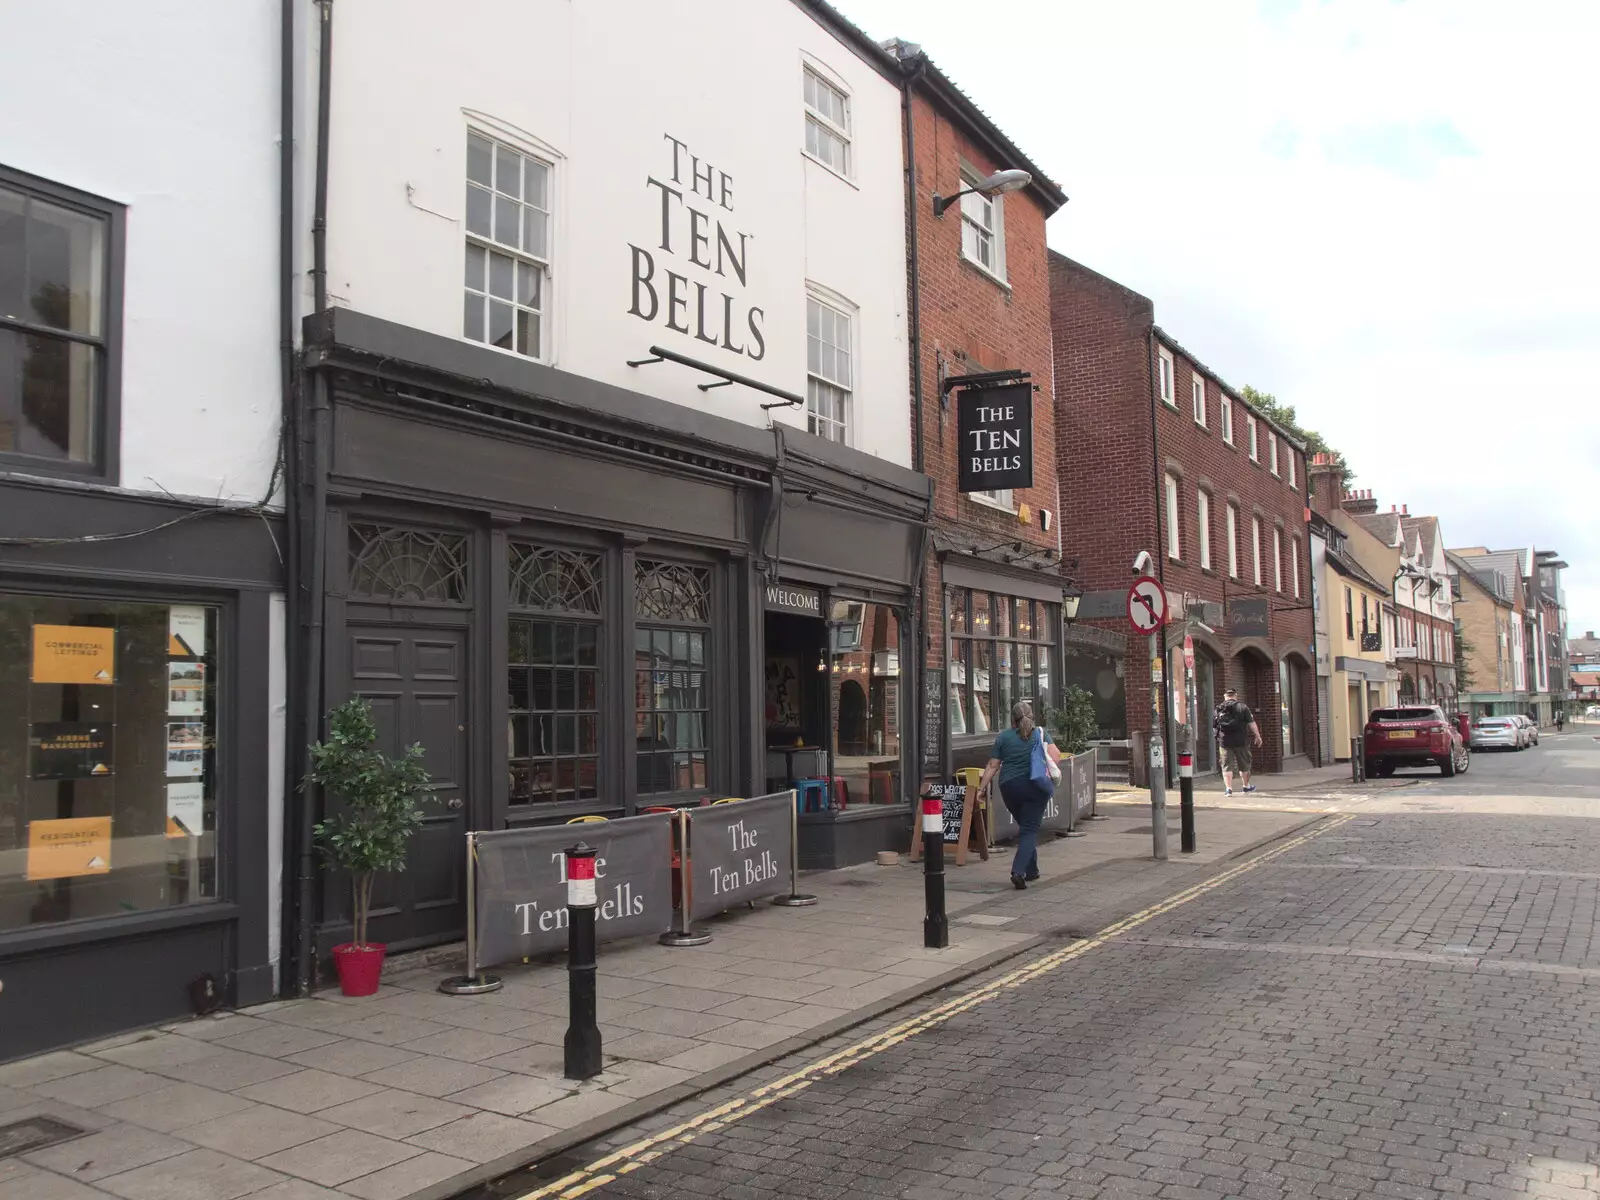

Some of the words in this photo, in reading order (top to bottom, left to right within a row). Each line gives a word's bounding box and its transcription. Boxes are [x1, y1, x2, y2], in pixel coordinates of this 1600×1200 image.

[664, 133, 734, 212] THE
[647, 175, 749, 288] TEN
[627, 242, 765, 361] BELLS
[976, 406, 1014, 423] THE
[969, 429, 1021, 451] TEN
[971, 455, 1021, 473] BELLS
[767, 586, 819, 610] WELCOME
[45, 641, 103, 650] COMMERCIAL
[728, 819, 758, 852] The
[943, 832, 960, 840] WEEK
[551, 852, 607, 884] Te
[710, 866, 740, 895] Ten
[744, 850, 778, 885] Bells
[514, 901, 569, 936] Ten
